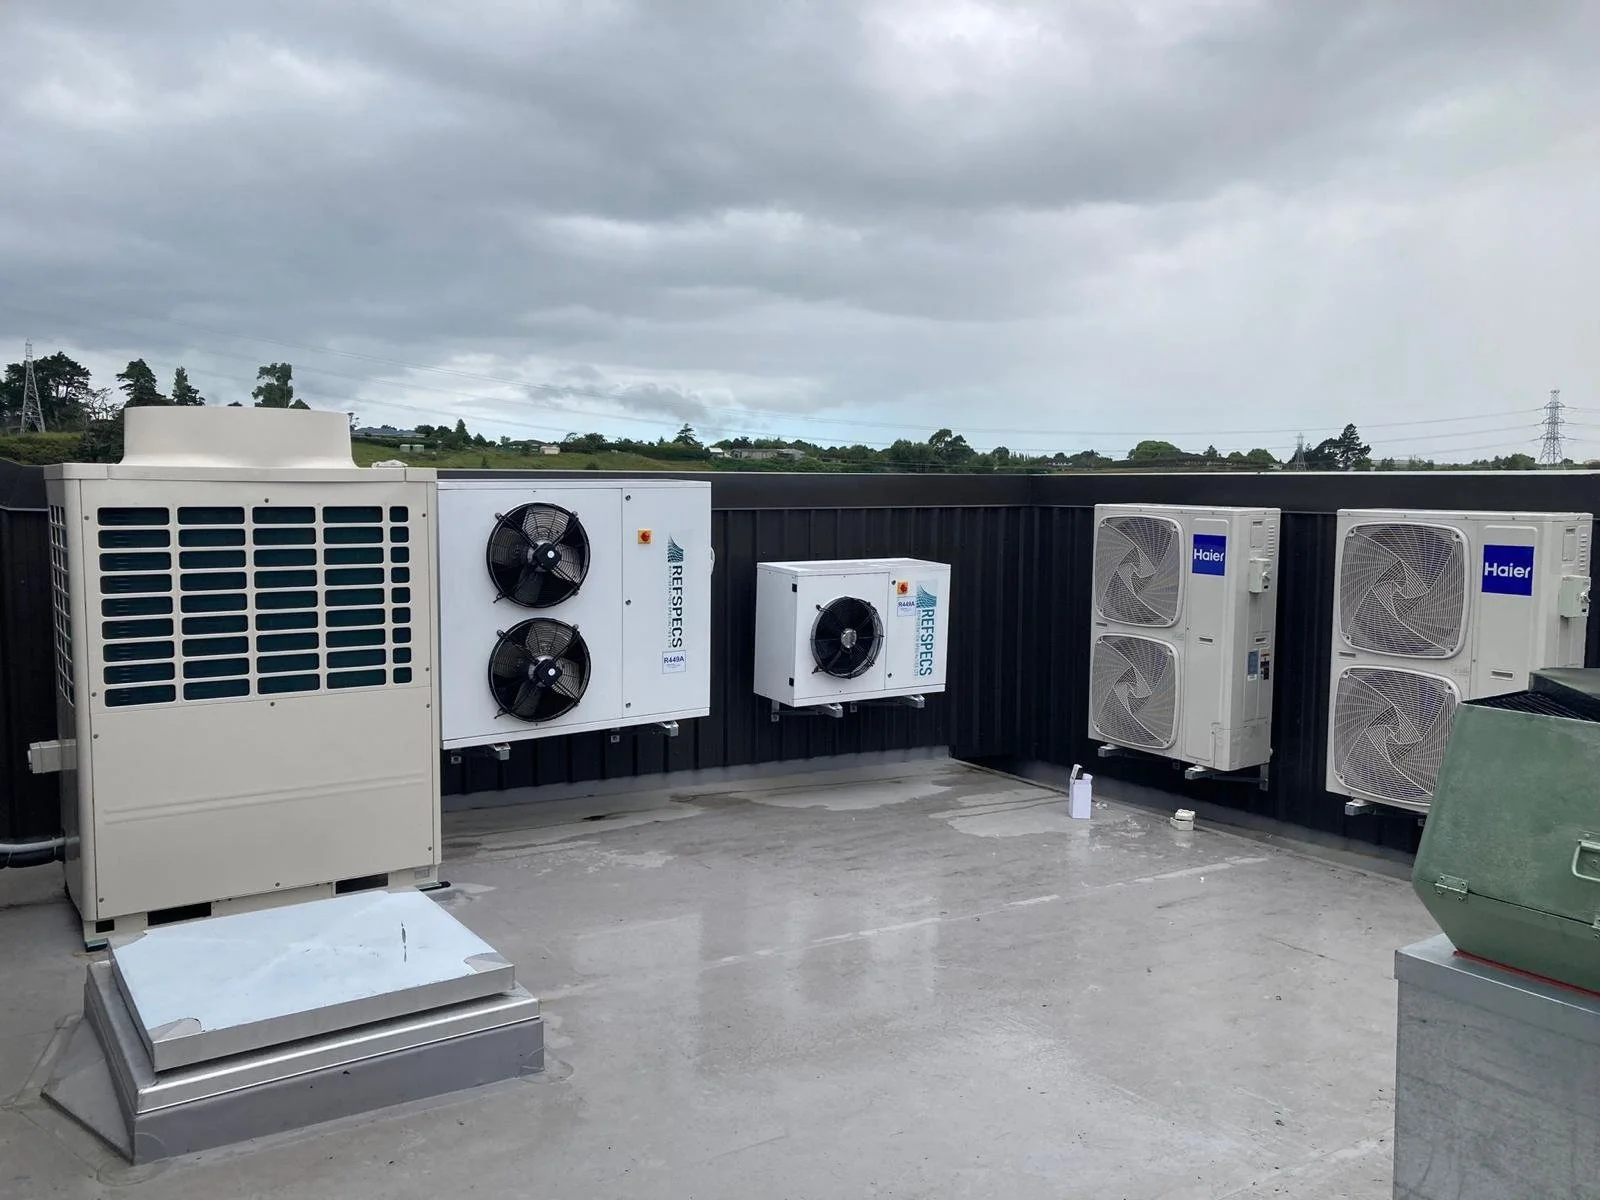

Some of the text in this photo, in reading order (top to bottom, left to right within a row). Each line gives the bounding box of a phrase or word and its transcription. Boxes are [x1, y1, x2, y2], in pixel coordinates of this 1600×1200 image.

[1193, 549, 1225, 562] Haier
[1484, 562, 1531, 579] Haier
[672, 565, 683, 648] REFSPECS
[919, 609, 935, 676] REFSPECS
[664, 656, 685, 664] R449A
